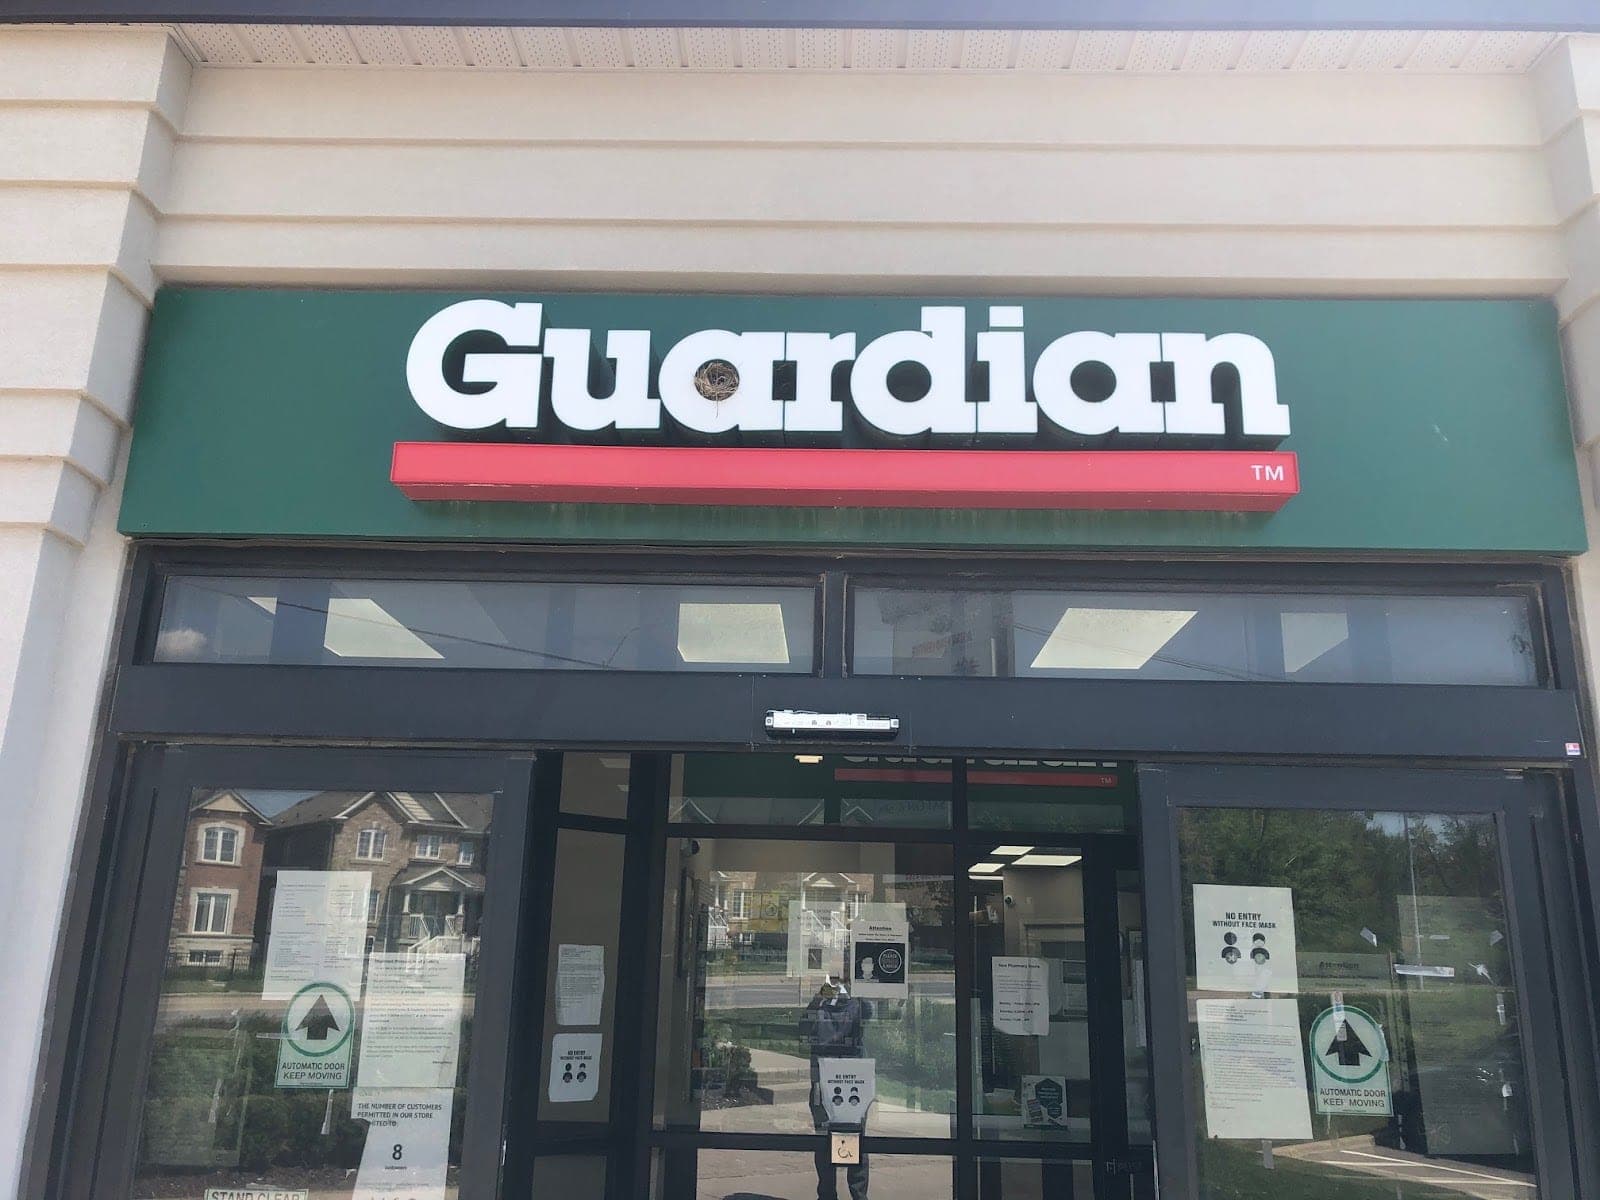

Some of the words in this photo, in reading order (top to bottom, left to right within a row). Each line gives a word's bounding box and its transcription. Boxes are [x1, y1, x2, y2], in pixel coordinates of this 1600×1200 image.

[406, 299, 1291, 435] Guardian
[1250, 464, 1284, 481] TM
[1226, 912, 1236, 920] NO
[282, 1062, 323, 1070] AUTOMATIC
[283, 1071, 306, 1080] KEEP
[307, 1071, 342, 1080] MOVING
[1320, 1088, 1363, 1097] AUTOMATIC
[1363, 1089, 1386, 1098] DOOR
[1349, 1099, 1385, 1108] MOVING
[392, 1144, 403, 1160] 8
[211, 1191, 253, 1200] STAND
[258, 1192, 300, 1200] CLEAR
